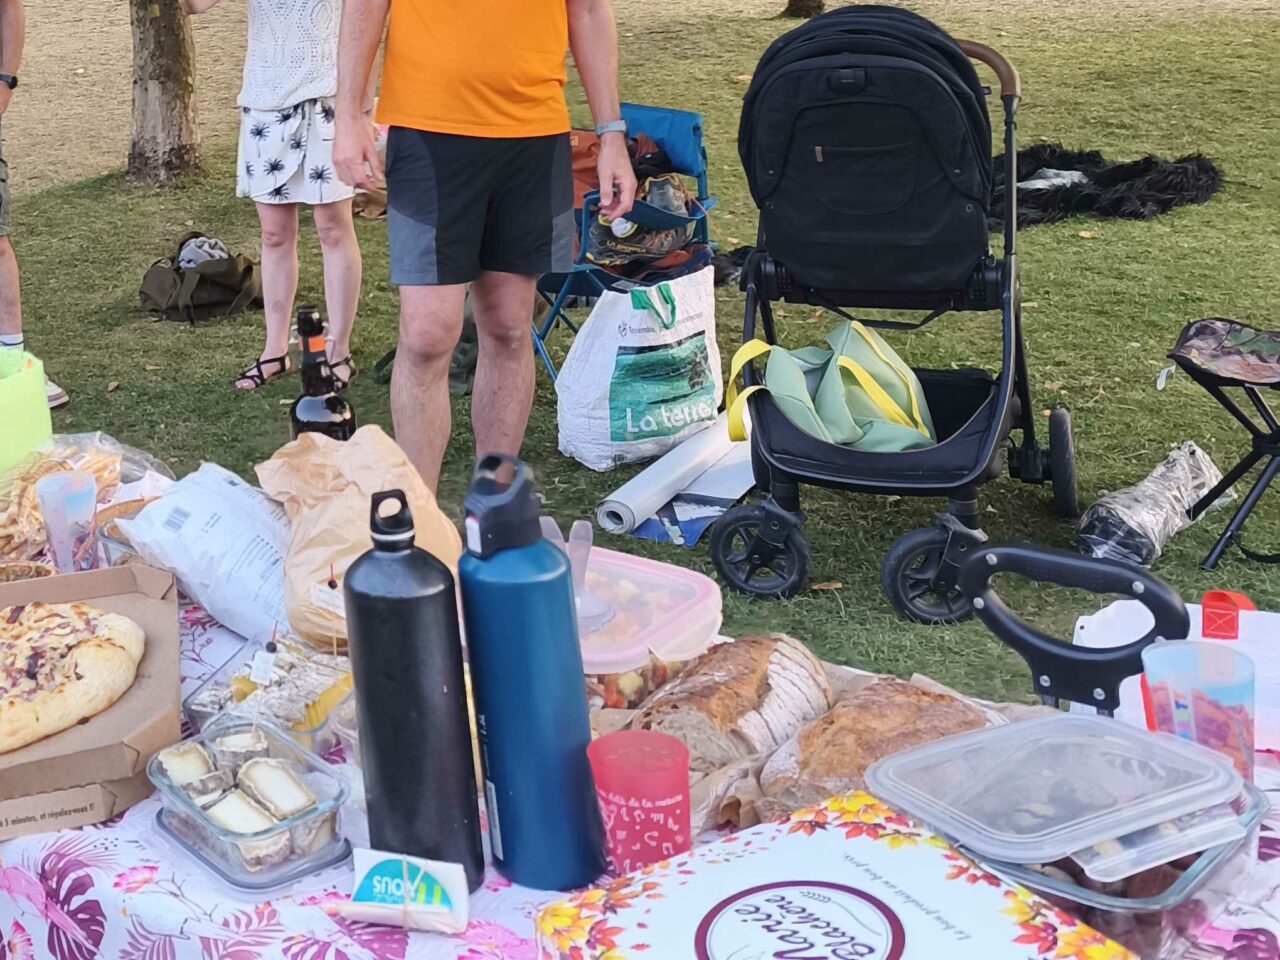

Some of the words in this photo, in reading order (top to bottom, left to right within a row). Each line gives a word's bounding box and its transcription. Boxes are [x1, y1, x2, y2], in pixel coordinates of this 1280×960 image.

[626, 407, 658, 433] La
[11, 814, 38, 826] minutes,
[39, 811, 46, 820] et
[862, 865, 882, 882] bon
[881, 878, 895, 889] au
[895, 888, 941, 920] produit
[932, 913, 956, 931] bon
